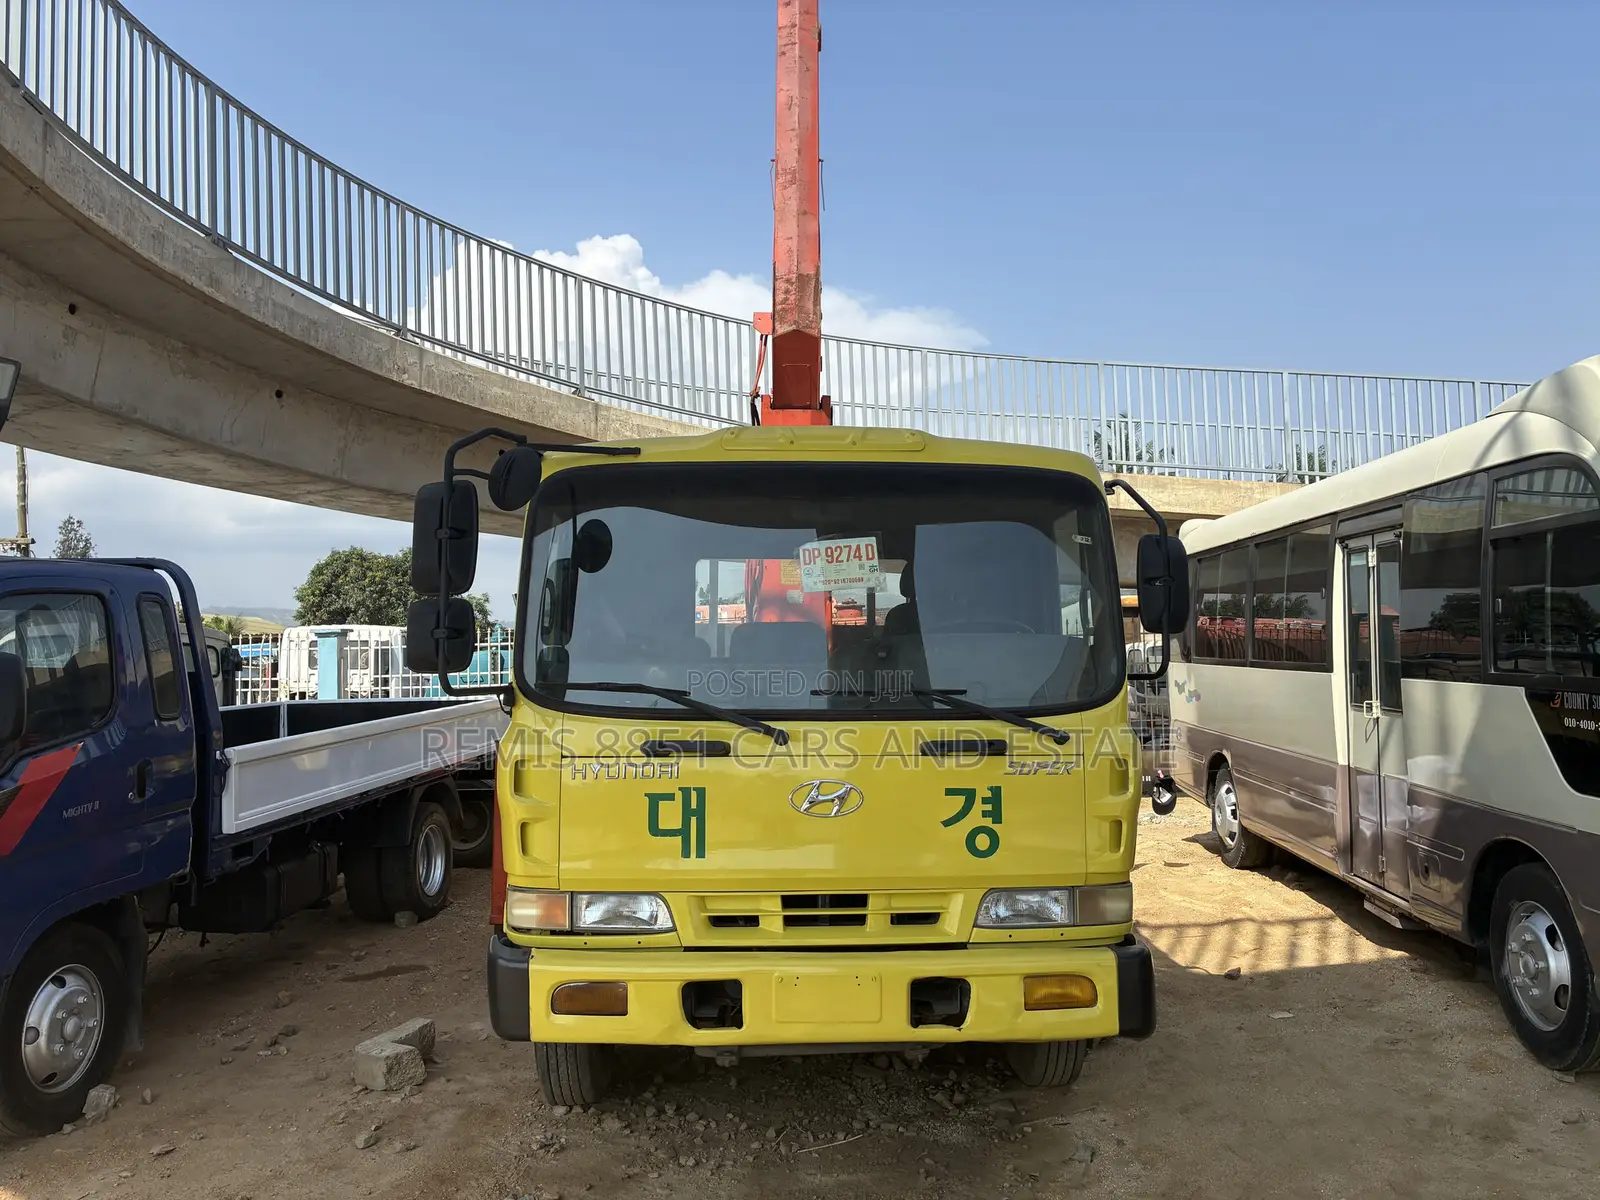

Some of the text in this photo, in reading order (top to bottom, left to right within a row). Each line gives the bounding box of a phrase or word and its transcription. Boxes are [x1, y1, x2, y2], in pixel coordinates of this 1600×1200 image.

[802, 543, 875, 565] DP 9274 D
[1563, 691, 1590, 710] COUNTY
[571, 762, 680, 780] HYUNDAI
[1003, 761, 1076, 776] SUPER
[62, 802, 93, 819] MIGHTY
[644, 785, 1003, 859] 대 경
